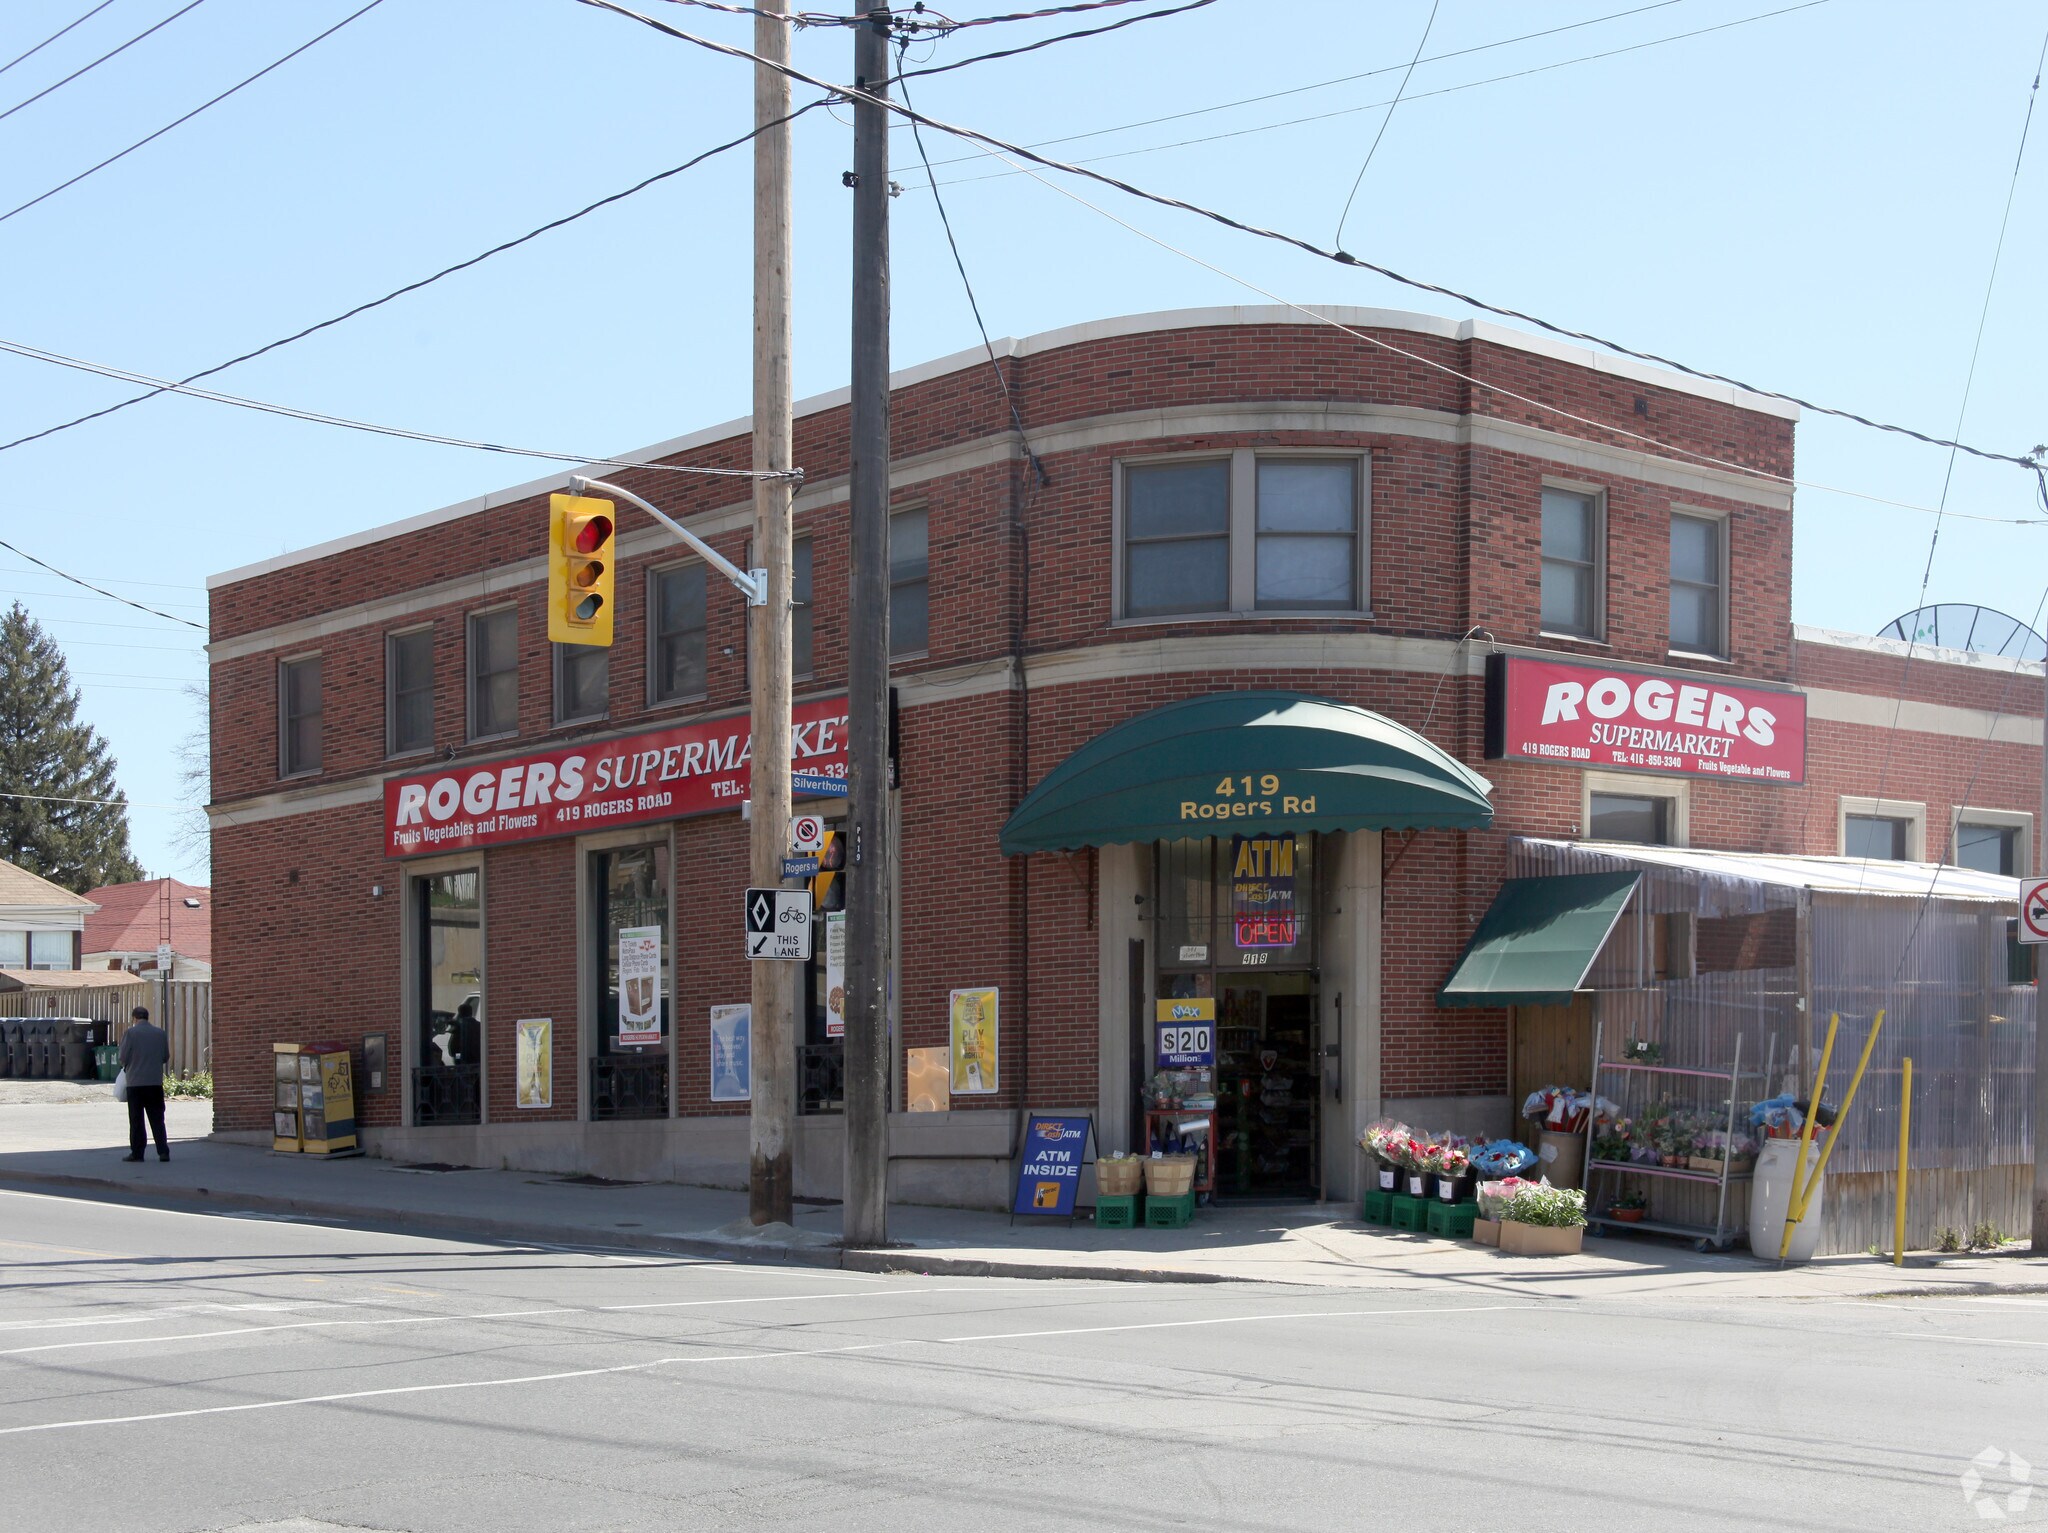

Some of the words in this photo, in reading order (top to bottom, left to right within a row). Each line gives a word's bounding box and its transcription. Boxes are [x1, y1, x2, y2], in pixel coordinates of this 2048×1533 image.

[1541, 677, 1776, 746] ROGERS
[1589, 723, 1734, 758] SUPERMARKET
[1522, 742, 1537, 754] 419
[1539, 744, 1569, 757] ROGERS
[1571, 747, 1590, 759] ROAD
[1612, 751, 1628, 762] TEL:
[1630, 753, 1643, 764] 416
[1699, 759, 1717, 771] Fruits
[1719, 761, 1750, 775] Vegetable
[1752, 765, 1764, 776] and
[1766, 767, 1790, 779] Flowers
[396, 756, 586, 826] ROGERS
[711, 780, 744, 797] TEL:
[793, 777, 848, 793] Silverthorn
[1215, 774, 1280, 797] 419
[556, 806, 580, 821] 419
[584, 798, 633, 818] ROGERS
[637, 792, 672, 810] ROAD
[1181, 799, 1272, 820] Rogers
[1283, 796, 1316, 814] Rd
[394, 829, 421, 846] Fruits
[423, 821, 474, 844] Vegetables
[477, 817, 496, 833] and
[499, 813, 538, 830] Flowers
[1234, 840, 1293, 877] ATM
[785, 859, 811, 875] Rogers
[777, 935, 799, 945] THIS
[1239, 923, 1293, 944] OPEN
[774, 947, 800, 957] LANE
[1243, 953, 1267, 965] 419
[1172, 1005, 1200, 1018] MAX
[962, 1029, 984, 1040] PLAY
[1164, 1031, 1207, 1051] $20
[1170, 1055, 1198, 1063] Million
[1035, 1122, 1064, 1131] DIRECT
[1063, 1130, 1082, 1138] ATM
[1036, 1150, 1070, 1162] ATM
[1023, 1165, 1078, 1176] INSIDE
